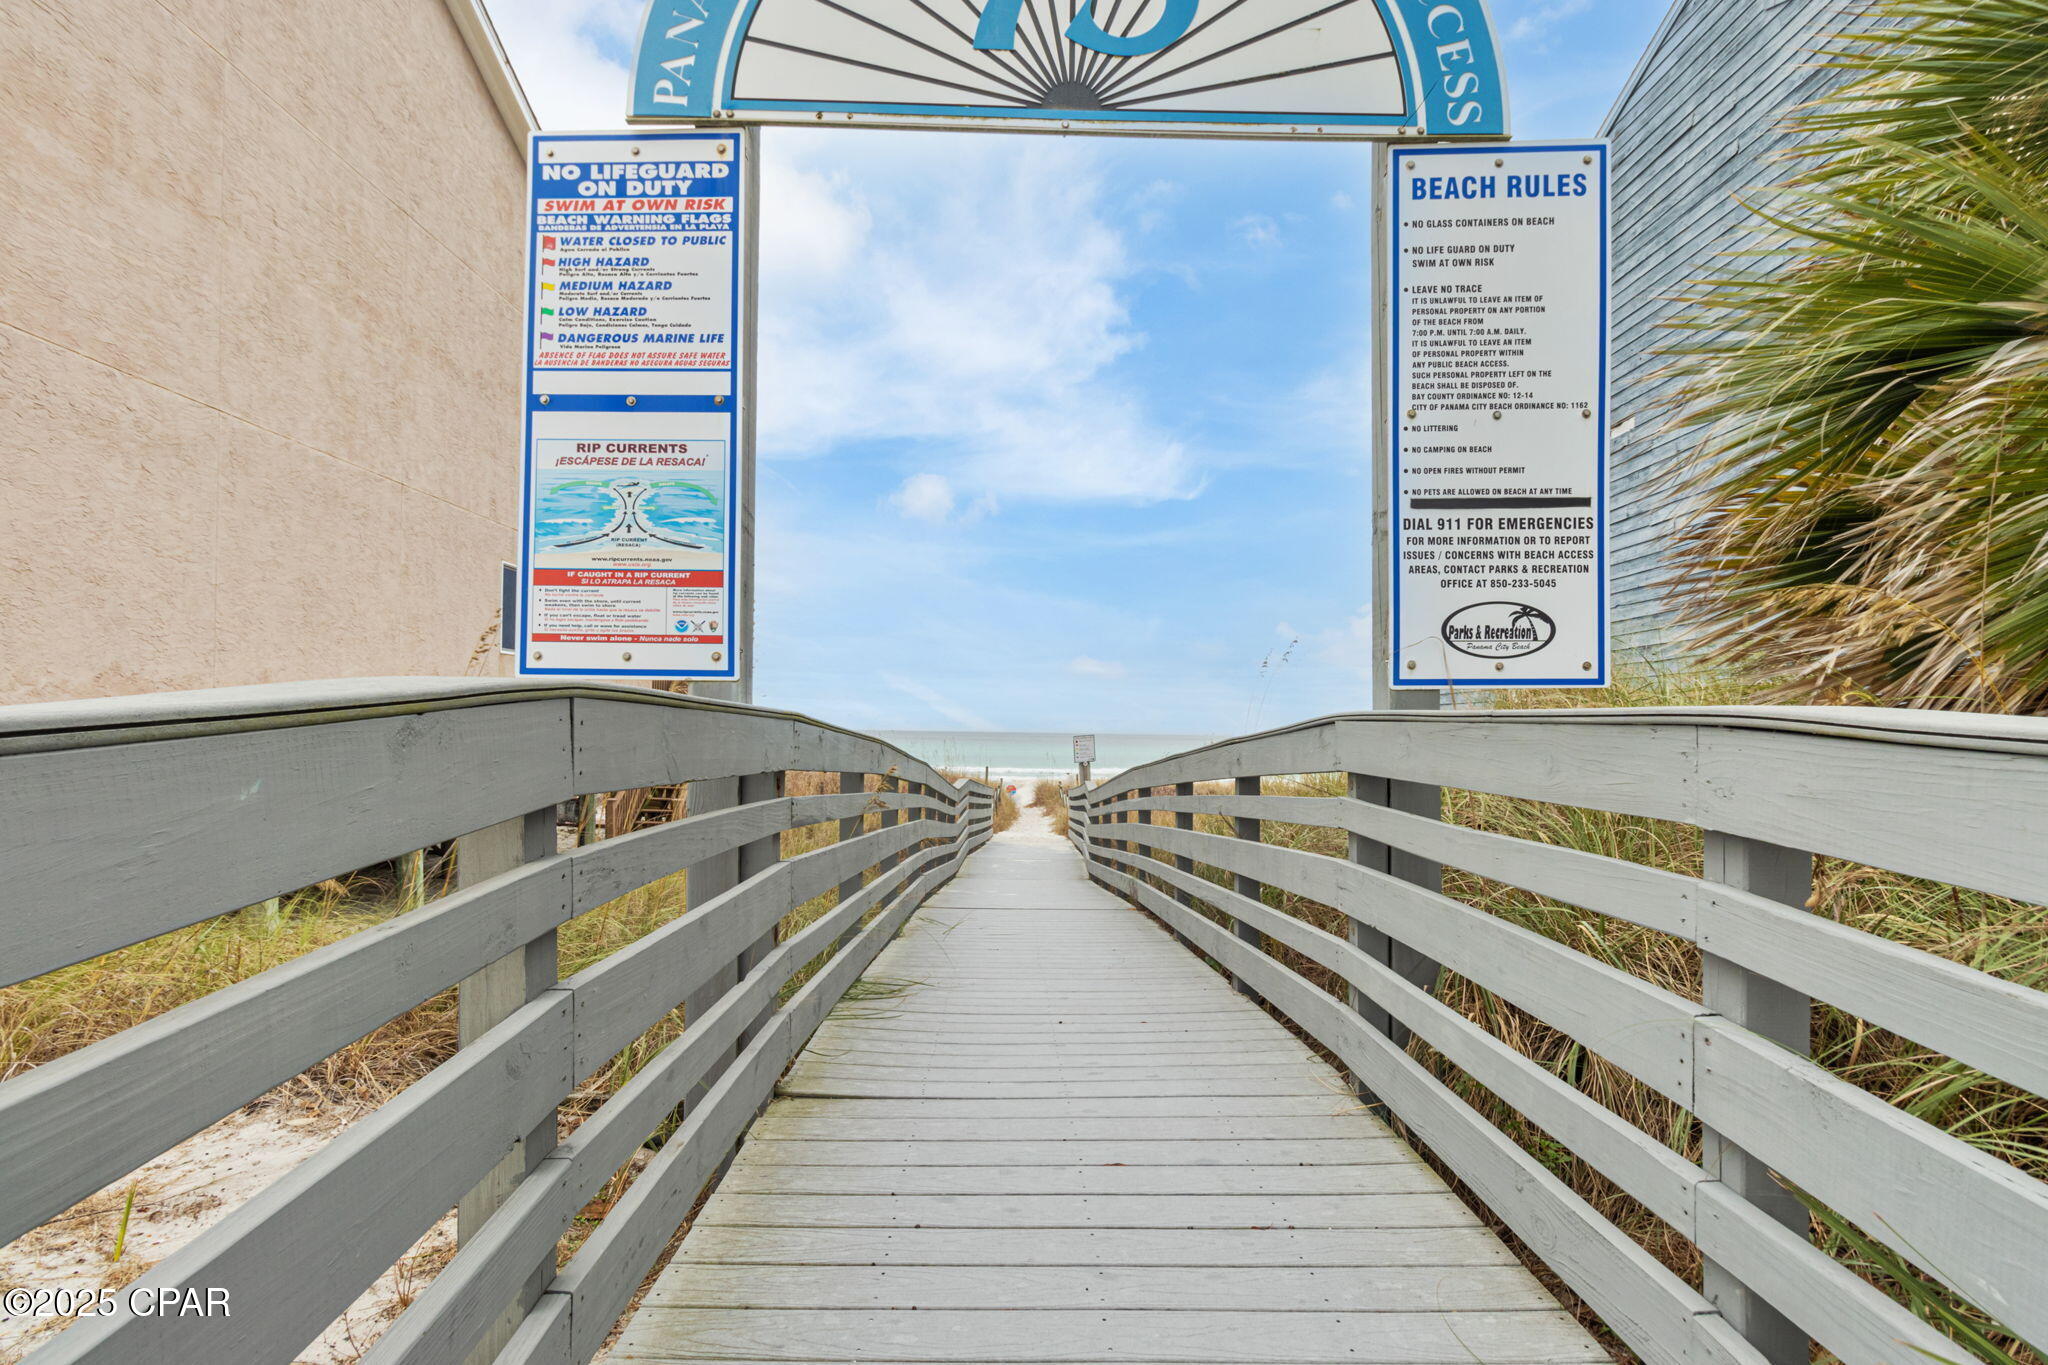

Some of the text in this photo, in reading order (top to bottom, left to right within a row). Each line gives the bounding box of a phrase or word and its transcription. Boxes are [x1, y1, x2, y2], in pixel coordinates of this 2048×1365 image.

[1418, 0, 1482, 126] CESS
[542, 164, 729, 180] NO LIFEGUARD
[578, 180, 692, 196] ON DUTY
[1412, 174, 1586, 200] BEACH RULES
[544, 198, 726, 211] SWIM AT OWN RISK
[537, 214, 731, 224] BEACH WARNING FLAGS
[1412, 217, 1554, 228] NO GLASS CONTAINERS ON BEACH
[560, 236, 727, 246] WATER CLOSED TO PUBLIC
[1412, 246, 1424, 254] NO
[1427, 246, 1444, 254] LIFE
[1448, 245, 1476, 253] GUARD
[1479, 245, 1490, 253] ON
[558, 258, 650, 266] HIGH HAZARD
[1475, 258, 1494, 266] RISK
[560, 282, 673, 290] MEDIUM HAZARD
[1412, 285, 1437, 293] LEAVE
[1441, 285, 1452, 293] NO
[558, 307, 648, 316] LOW HAZARD
[558, 334, 725, 343] DANGEROUS MARINE LIFE
[577, 444, 687, 453] RIP CURRENTS
[556, 456, 706, 466] ¡ESCÁPESE DE LA RESACA!
[1404, 517, 1593, 530] DIAL 911 FOR EMERGENCIES
[1407, 537, 1424, 545] FOR
[1428, 537, 1453, 545] MORE
[1458, 537, 1520, 545] INFORMATION
[1555, 536, 1589, 544] REPORT
[1445, 551, 1494, 559] CONCERNS
[1498, 551, 1521, 559] WITH
[1525, 551, 1554, 559] BEACH
[1409, 565, 1589, 574] AREAS, CONTACT PARKS & RECREATION
[1441, 580, 1556, 588] OFFICE AT 850-233-5045
[1448, 625, 1532, 640] Parks & Recreation
[1495, 643, 1510, 651] City
[1512, 642, 1530, 650] Beach
